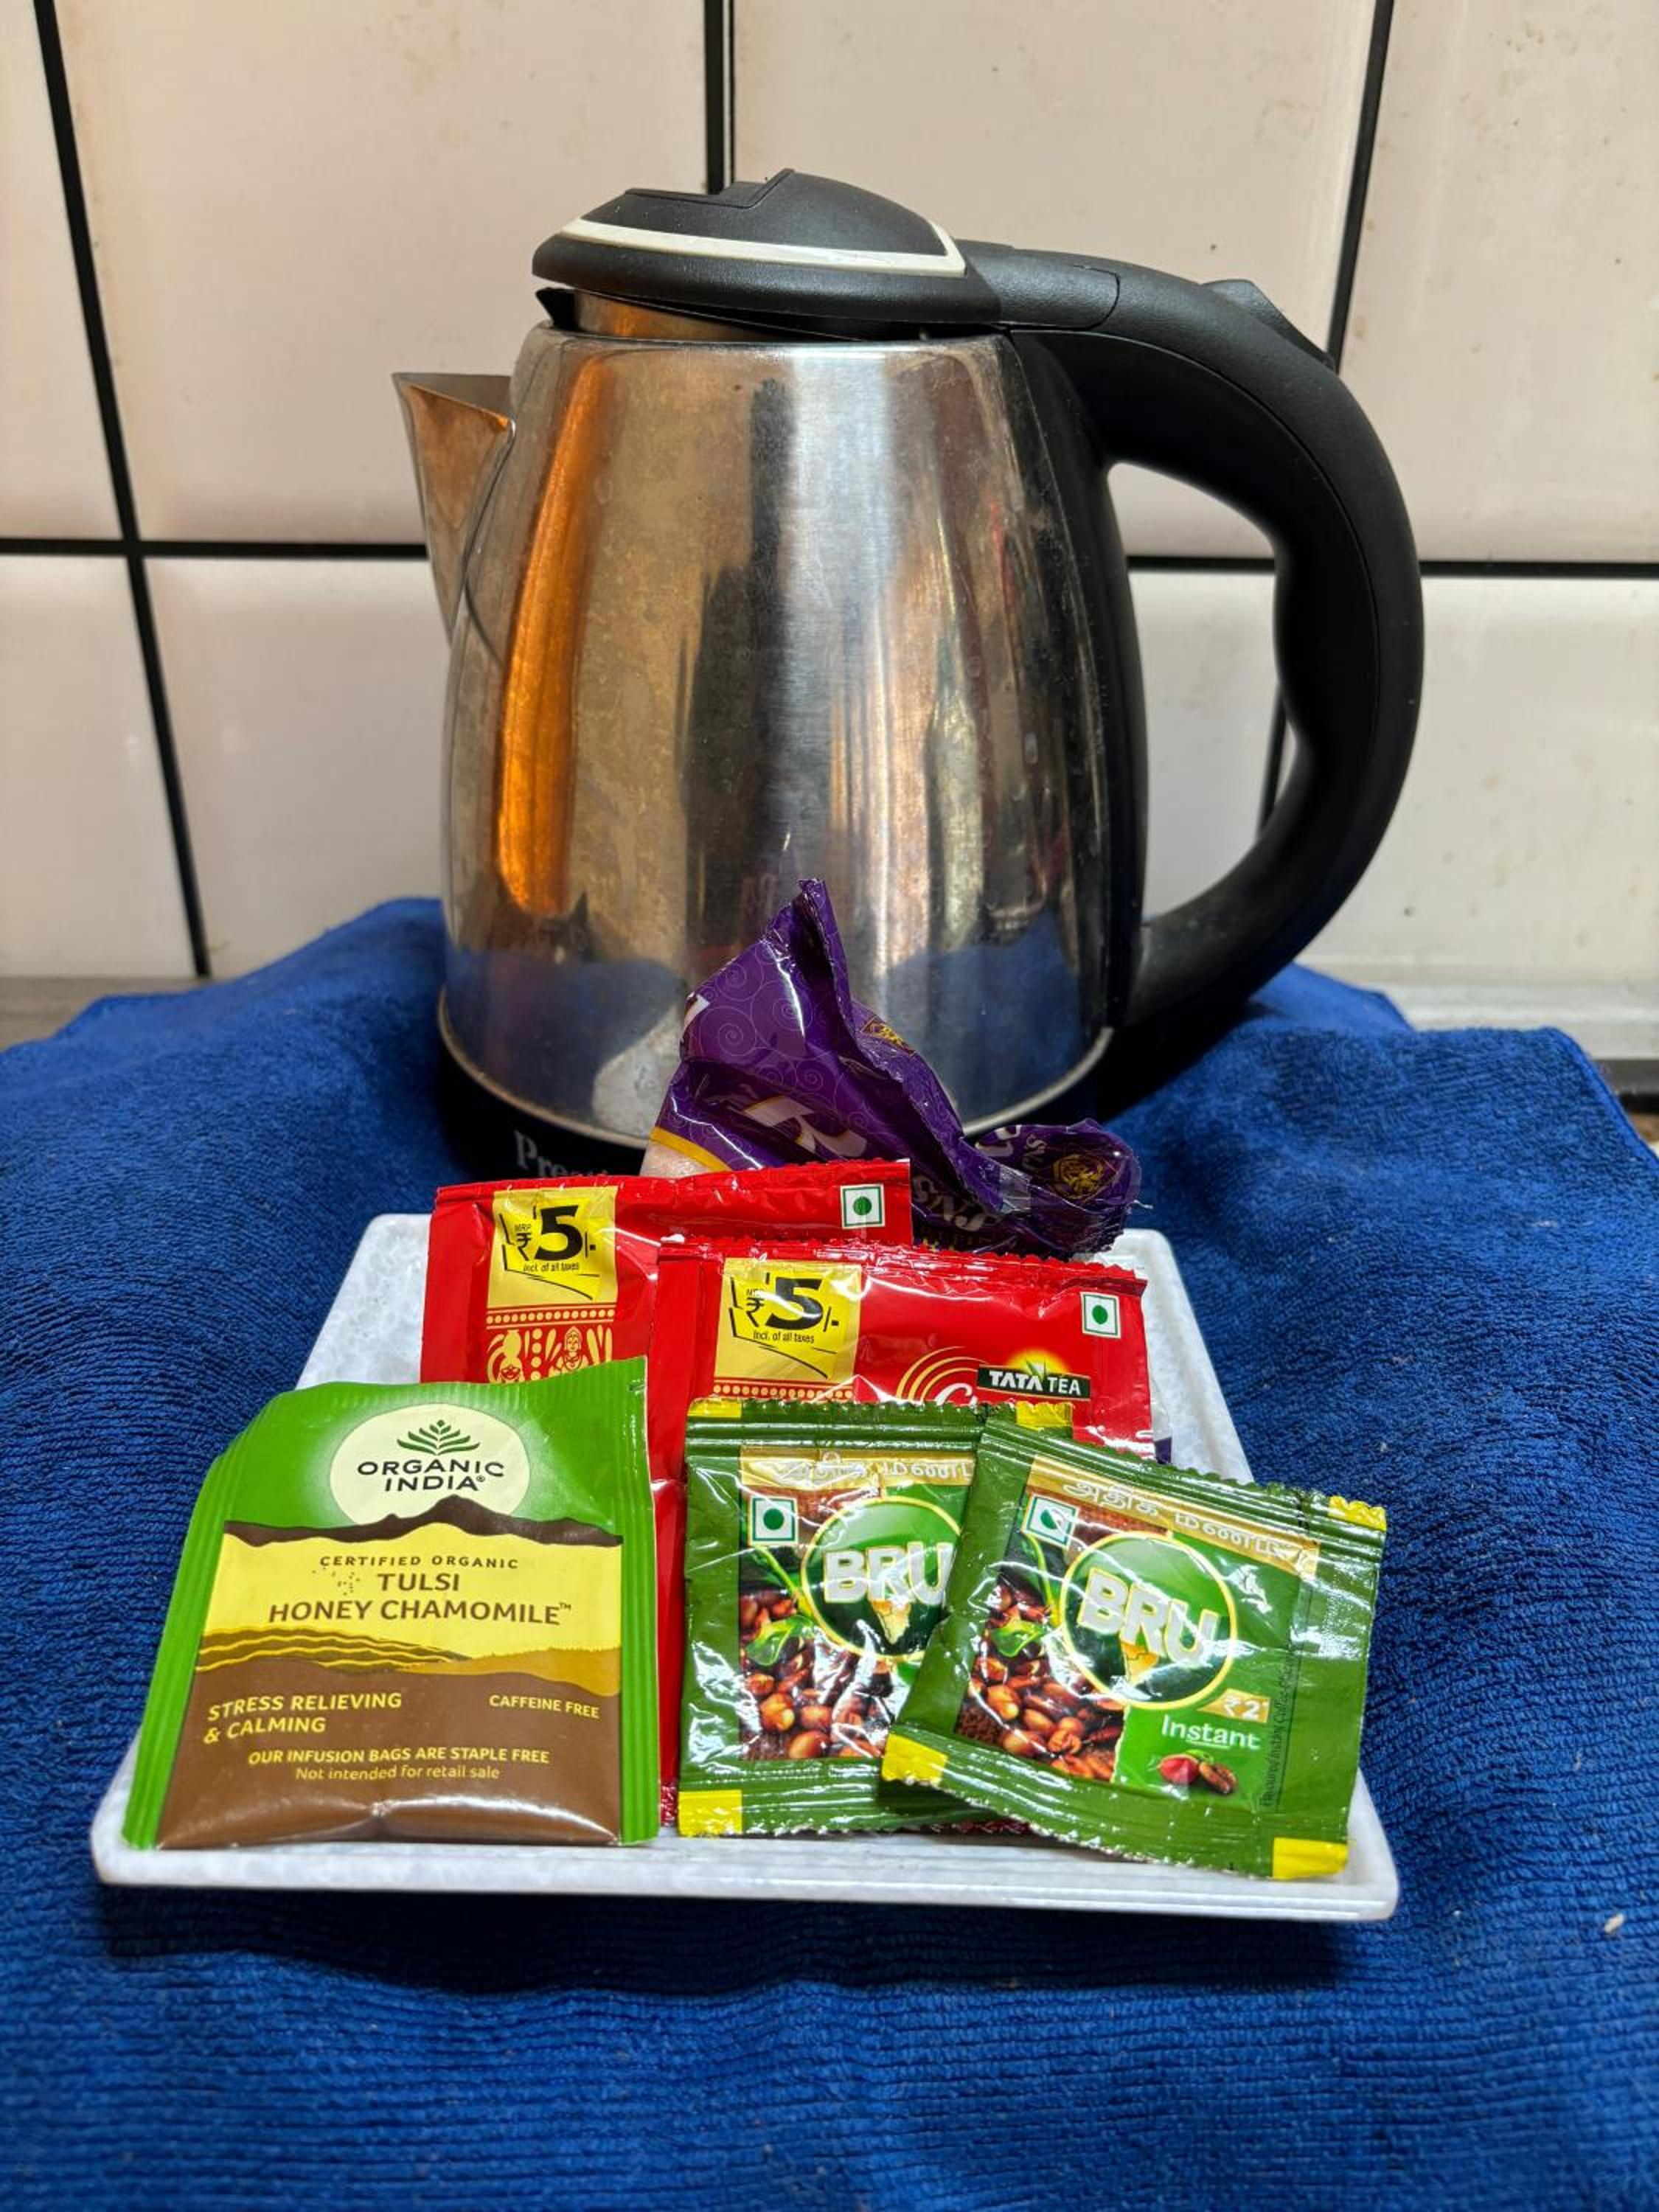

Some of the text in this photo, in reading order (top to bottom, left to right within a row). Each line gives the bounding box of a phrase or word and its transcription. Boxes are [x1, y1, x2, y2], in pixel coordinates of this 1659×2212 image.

[541, 1262, 550, 1271] of
[561, 1262, 579, 1270] taxes
[772, 1332, 781, 1340] of
[794, 1334, 814, 1343] taxes
[989, 1369, 1081, 1395] TATA TEA
[357, 1458, 504, 1478] ORGANIC
[320, 1554, 518, 1569] CERTIFIED ORGANIC
[824, 1542, 953, 1604] BRU
[377, 1573, 460, 1592] TULSI
[268, 1600, 373, 1623] HONEY
[1076, 1568, 1220, 1664] BRU
[207, 1692, 403, 1722] STRESS RELIEVING
[489, 1695, 600, 1719] CAFFEINE FREE
[204, 1717, 327, 1744] & CALMING
[1161, 1715, 1260, 1750] Instant
[248, 1746, 550, 1765] OUR INFUSION BAGS ARE STAPLE FREE
[296, 1764, 500, 1780] Not intended for retail sale
